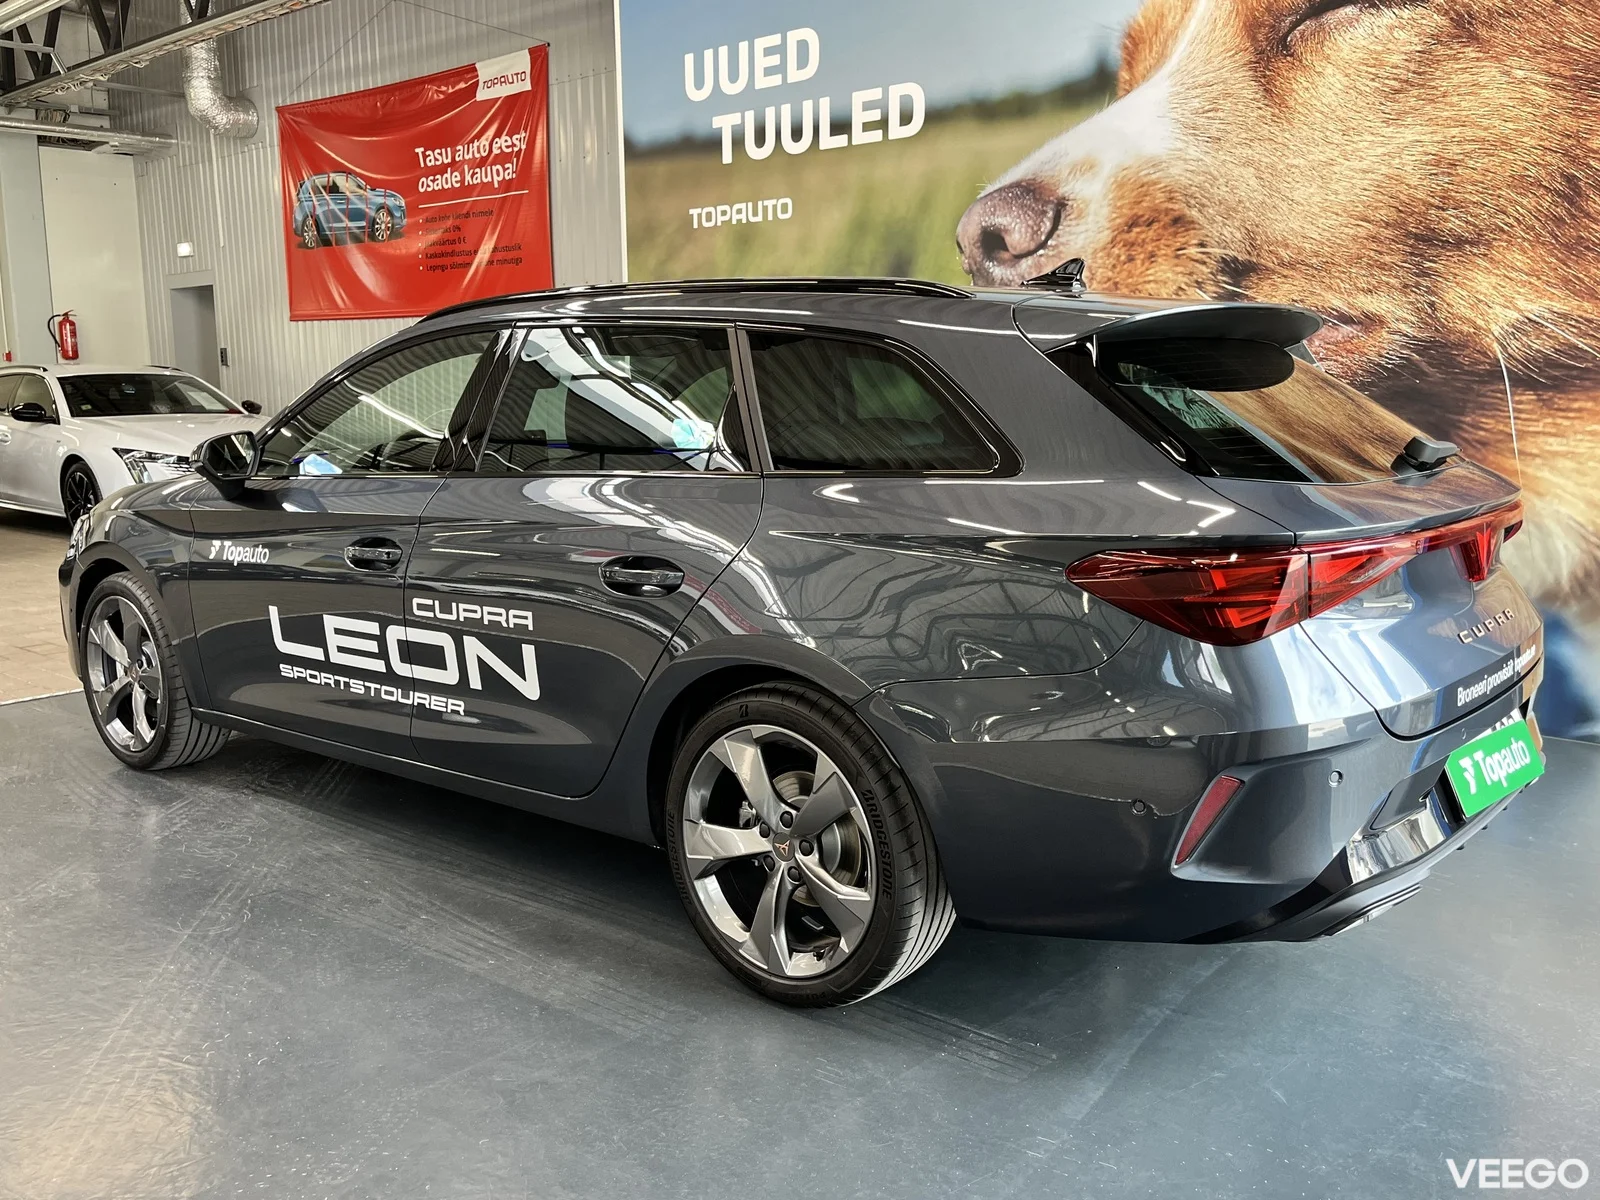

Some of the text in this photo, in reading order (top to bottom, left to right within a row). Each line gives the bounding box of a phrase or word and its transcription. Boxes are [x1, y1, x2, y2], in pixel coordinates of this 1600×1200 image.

[482, 70, 527, 90] TOPAUTO
[684, 27, 820, 102] UUED
[712, 82, 926, 165] TUULED
[414, 130, 527, 168] Tasu auto eest
[418, 158, 517, 193] osade kaupa!
[472, 208, 494, 218] nimele
[688, 197, 793, 229] TOPAUTO
[425, 249, 472, 260] Kaskokindlustus
[426, 263, 449, 273] Lepingu
[495, 256, 523, 267] minutiga
[222, 540, 270, 567] Topauto
[412, 597, 534, 631] CUPRA
[1457, 608, 1515, 645] CUPRA
[268, 604, 541, 701] LEON
[279, 663, 465, 716] SPORTSTOURER
[1457, 674, 1488, 707] Broneeri
[1474, 737, 1531, 788] Topauto
[861, 789, 893, 900] BRIDGESTONE
